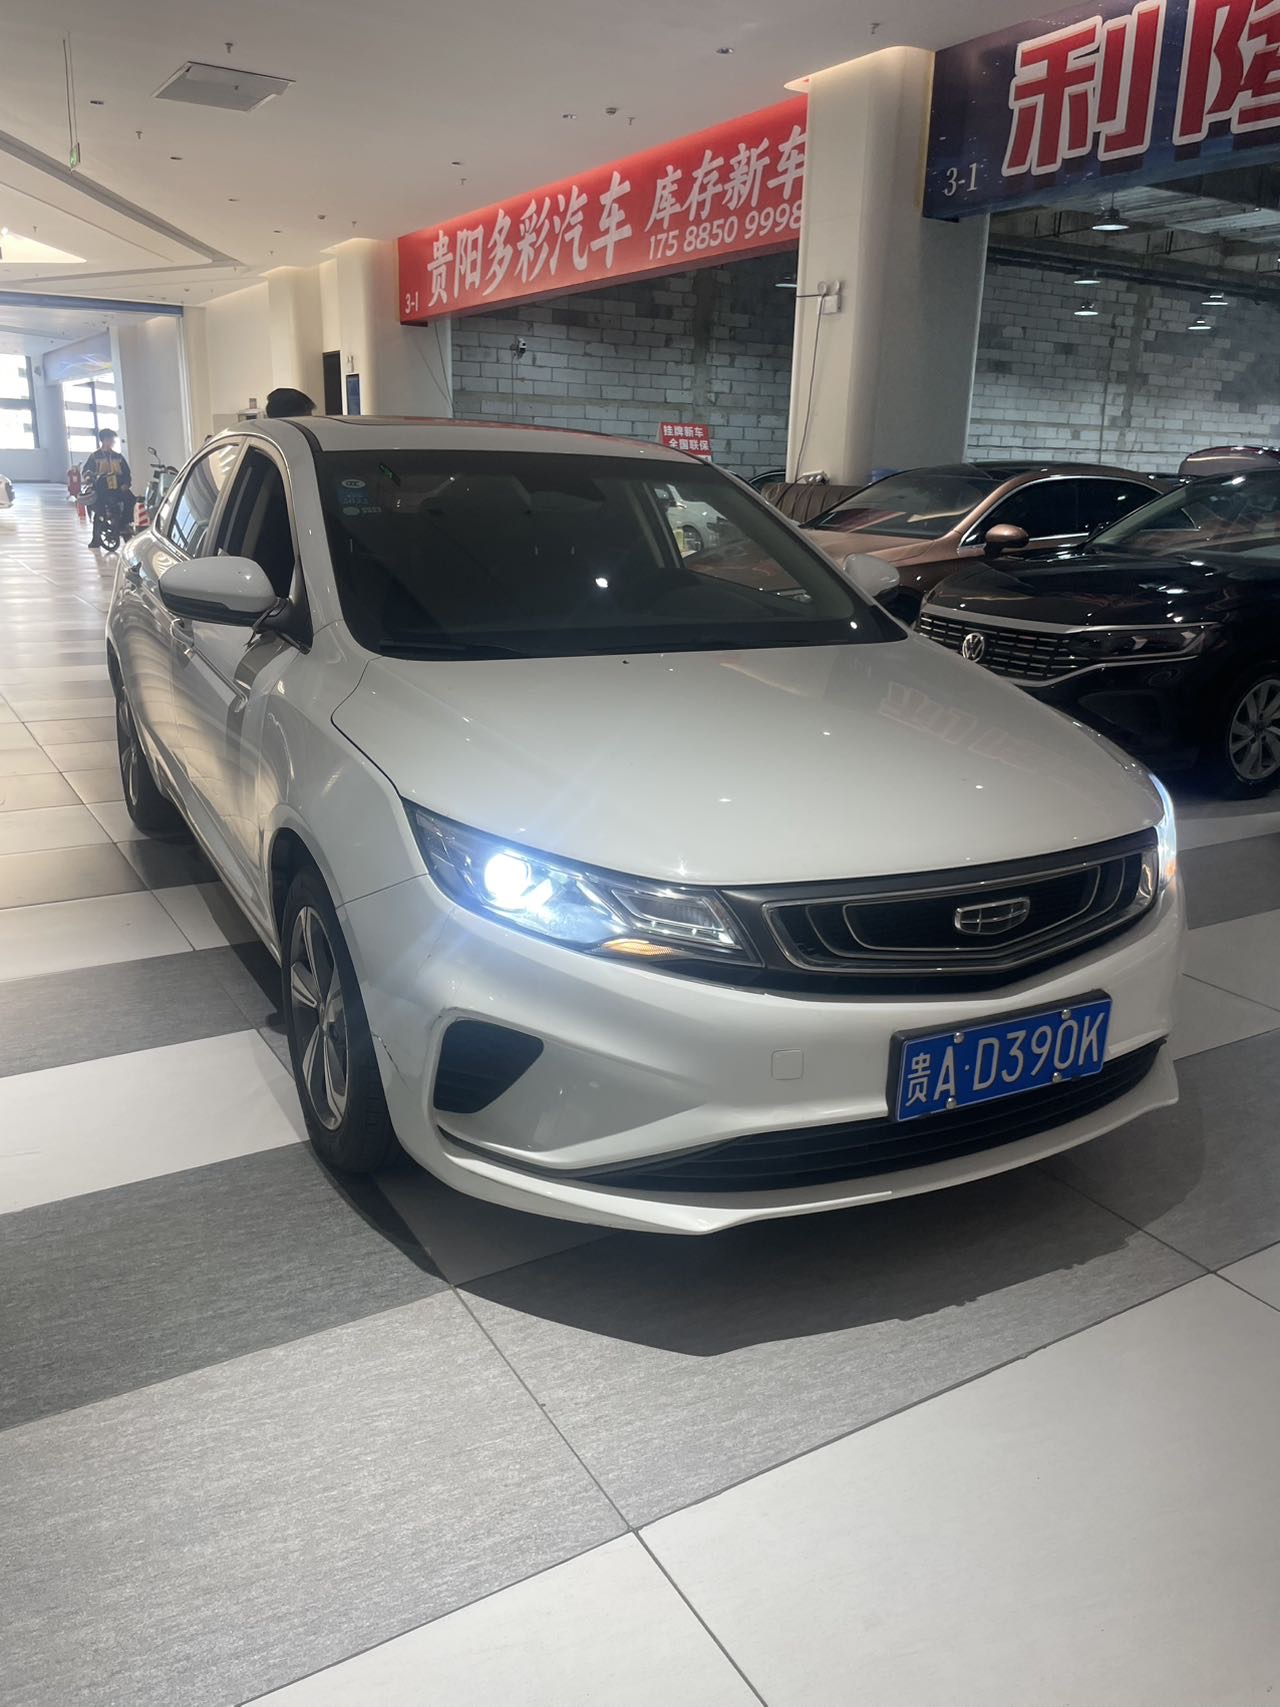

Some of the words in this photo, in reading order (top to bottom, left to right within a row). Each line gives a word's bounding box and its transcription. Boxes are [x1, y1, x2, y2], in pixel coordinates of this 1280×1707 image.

[944, 162, 978, 197] 3-1
[427, 171, 632, 307] 贵阳多彩汽车
[644, 125, 807, 232] 库存新车
[649, 230, 679, 260] 175
[683, 215, 738, 253] 8850
[744, 199, 802, 240] 9998
[668, 438, 710, 451] 全国联保
